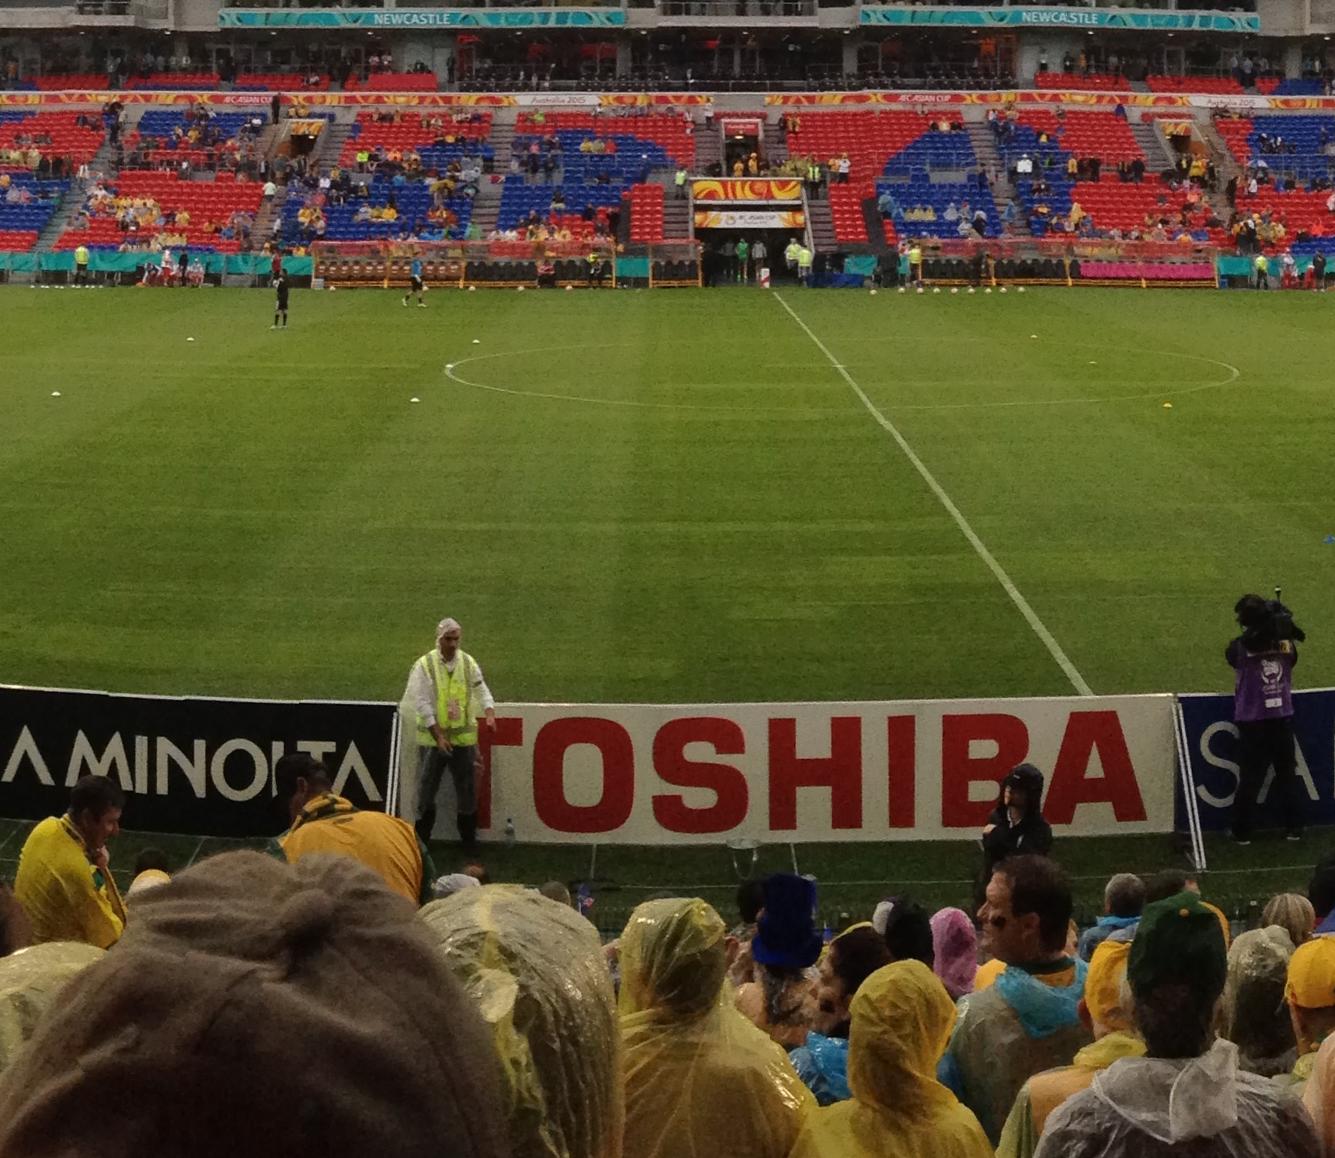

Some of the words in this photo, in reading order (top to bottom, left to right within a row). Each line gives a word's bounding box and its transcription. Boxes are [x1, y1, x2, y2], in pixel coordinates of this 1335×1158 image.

[374, 13, 450, 24] NEWCASTLE
[1022, 11, 1098, 24] NEWCASTLE
[261, 96, 273, 104] CU
